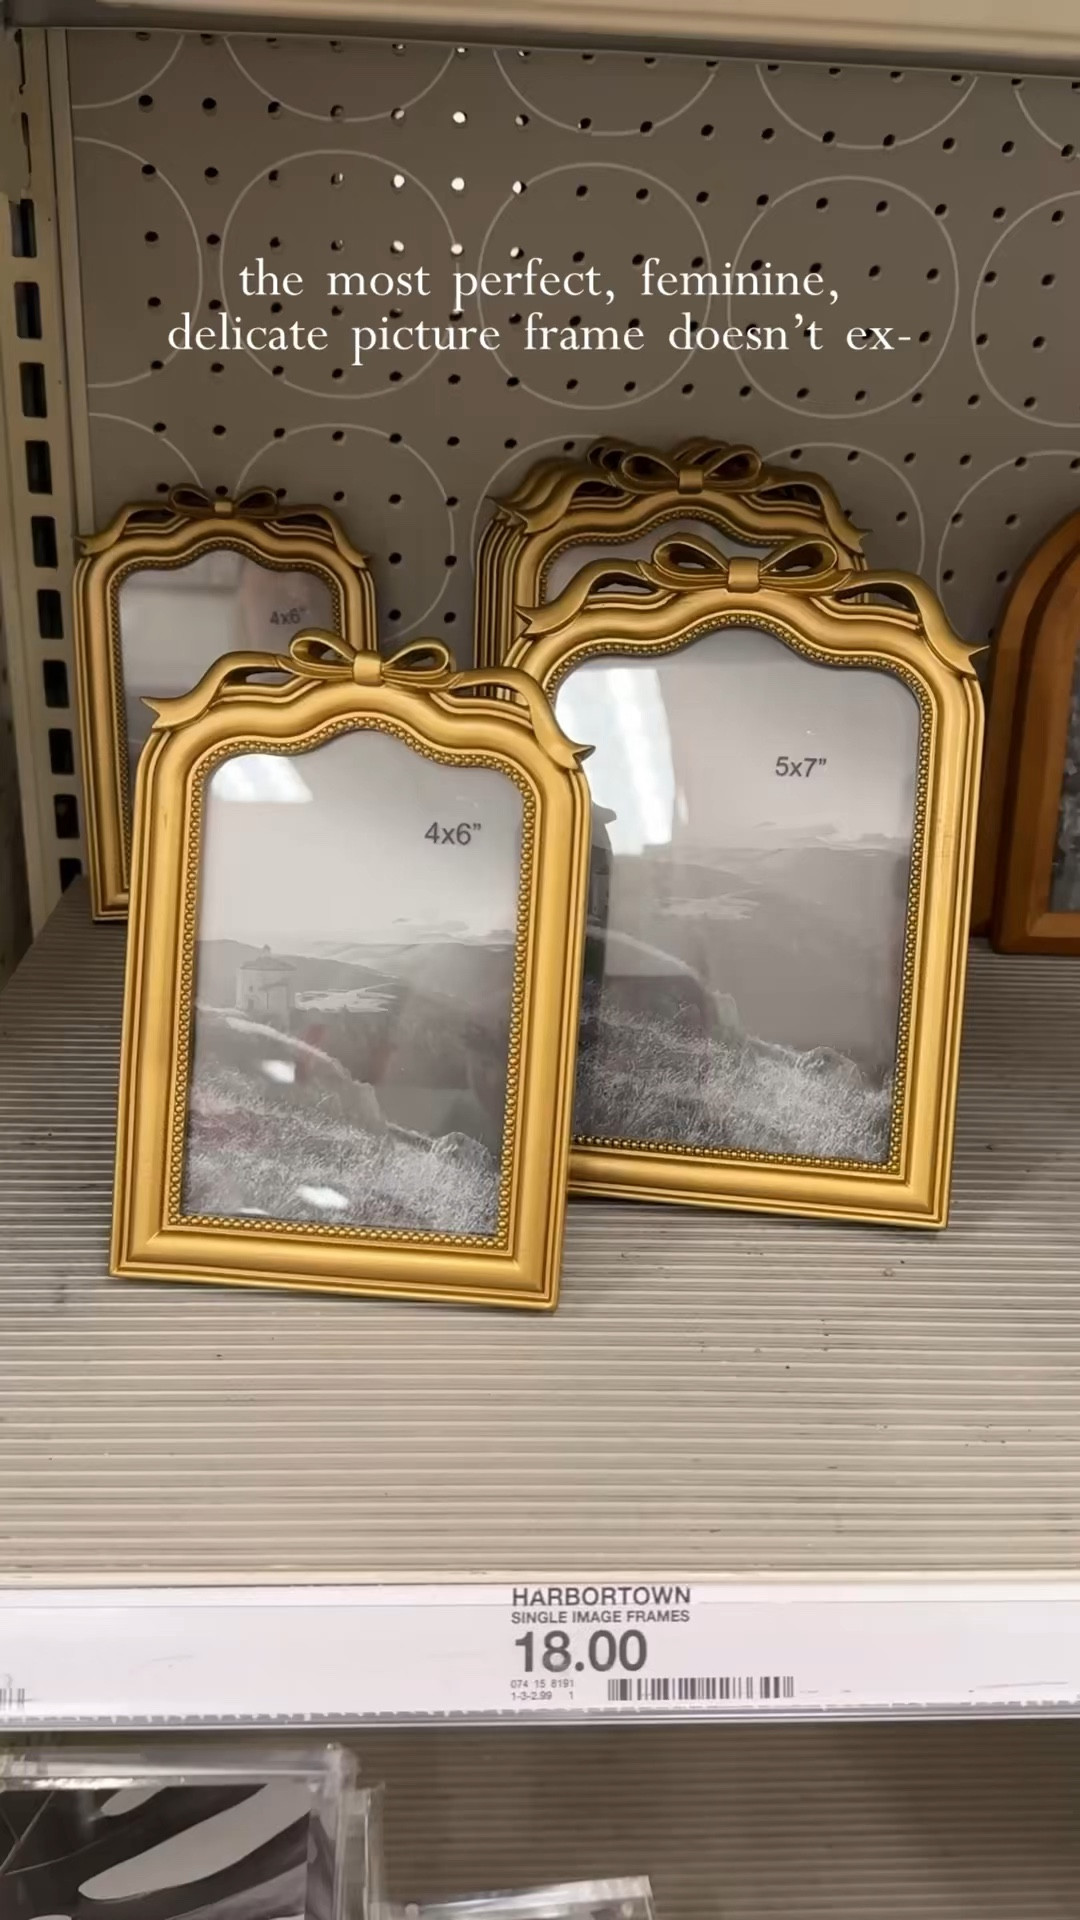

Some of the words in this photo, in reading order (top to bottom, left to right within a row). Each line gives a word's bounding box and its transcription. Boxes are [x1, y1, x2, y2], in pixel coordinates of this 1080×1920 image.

[512, 1586, 691, 1606] HARBORTOWN
[511, 1611, 567, 1624] SINGLE
[572, 1610, 622, 1623] IMAGE
[626, 1609, 690, 1622] FRAMES
[515, 1629, 648, 1673] 18.00
[510, 1679, 528, 1689] 074
[534, 1679, 546, 1689] 15
